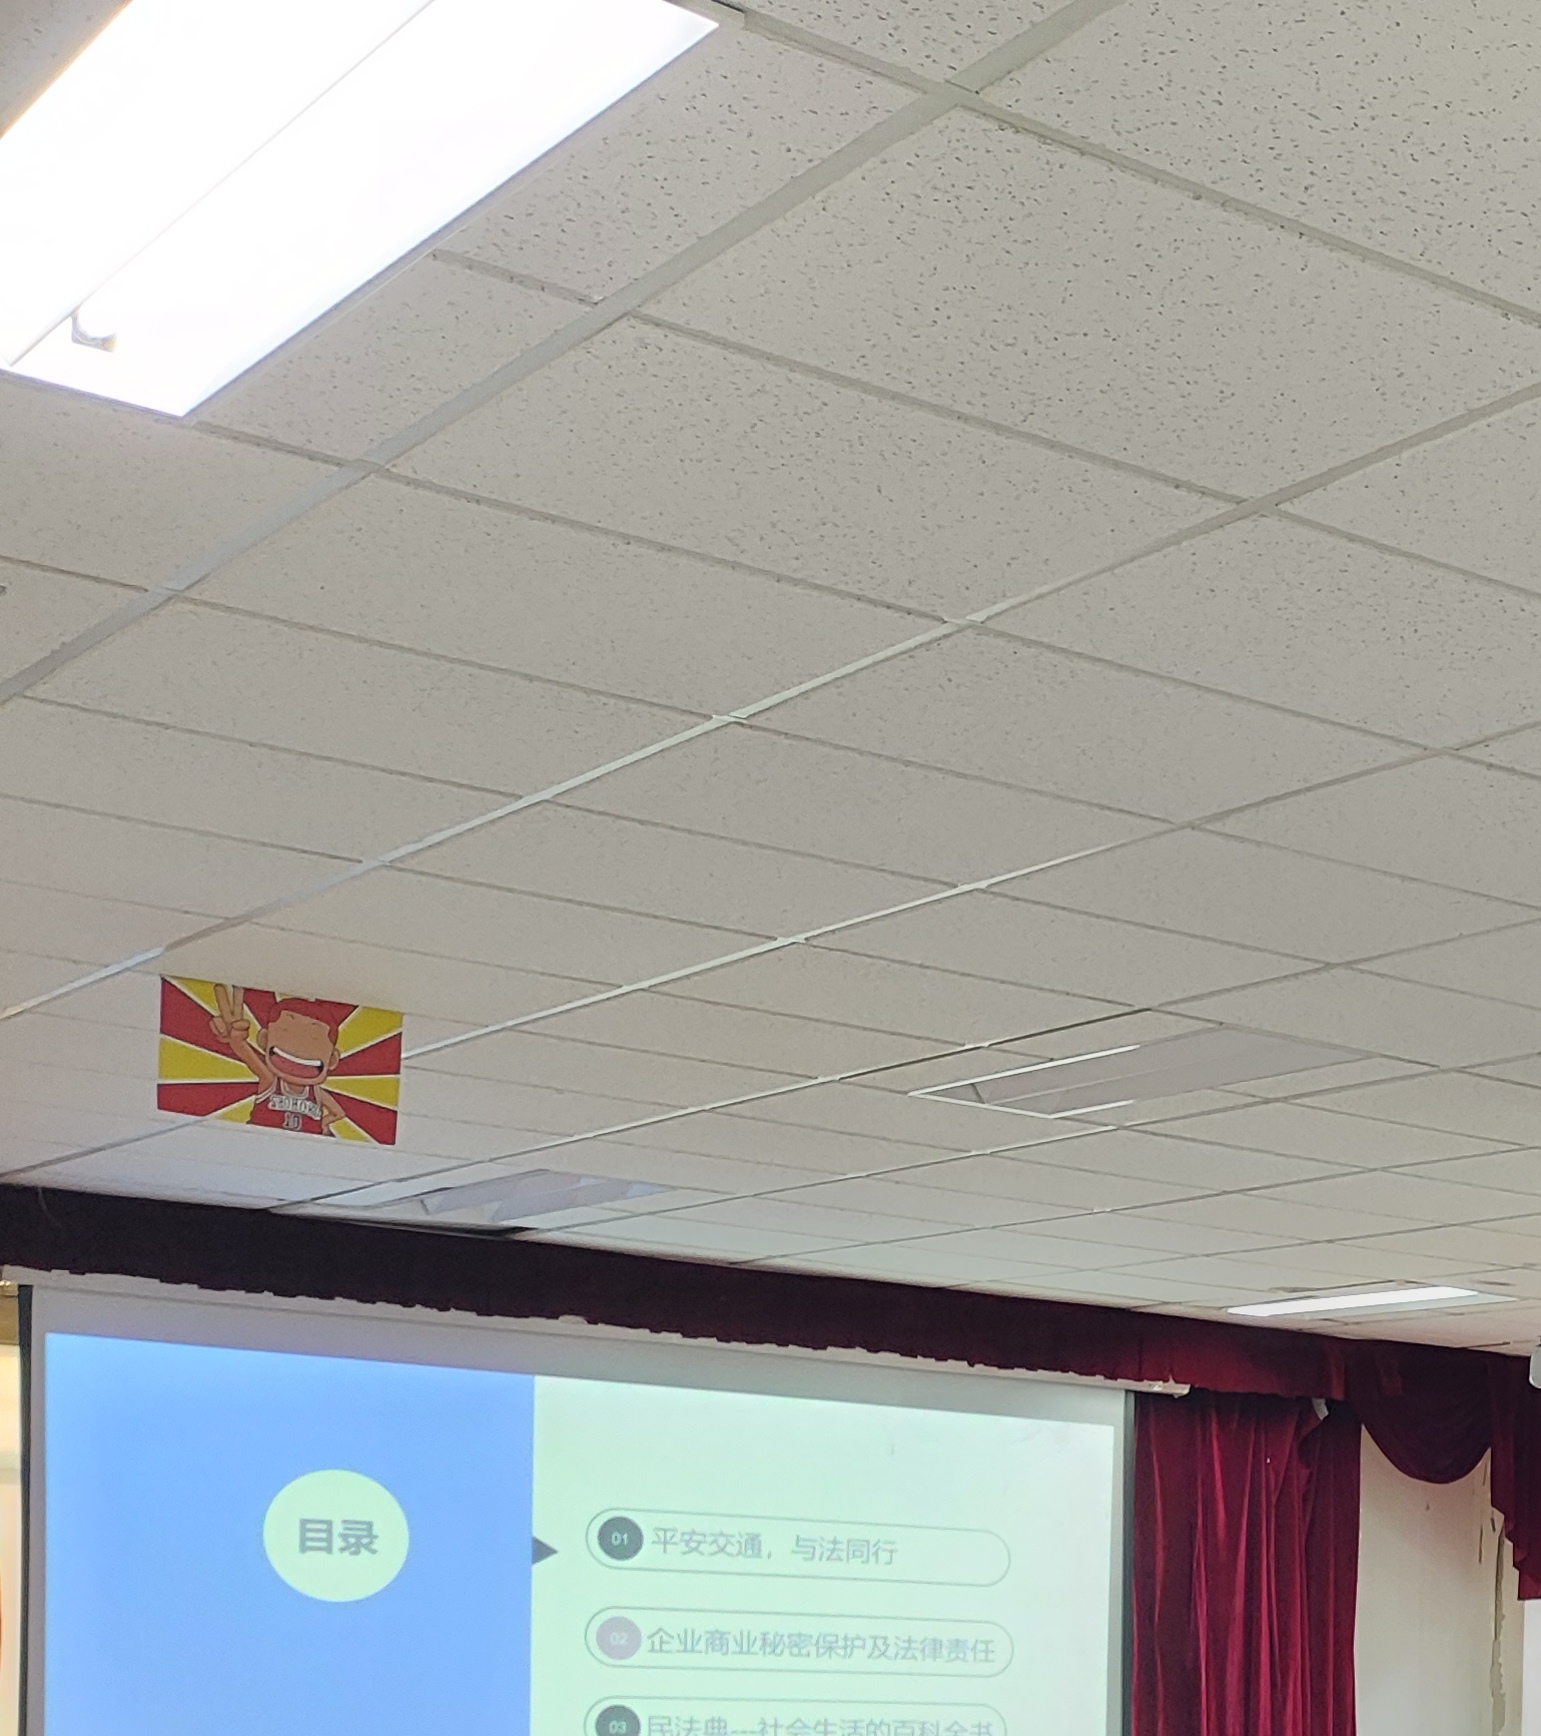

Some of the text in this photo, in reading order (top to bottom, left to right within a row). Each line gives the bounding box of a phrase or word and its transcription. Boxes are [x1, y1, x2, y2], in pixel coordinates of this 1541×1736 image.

[299, 1518, 380, 1556] 目录
[610, 1531, 629, 1547] 01
[651, 1526, 898, 1566] 平安交通，与法同行
[609, 1631, 629, 1647] 02
[646, 1626, 996, 1664] 企业商业秘密保护及法律责任
[608, 1720, 628, 1735] 03
